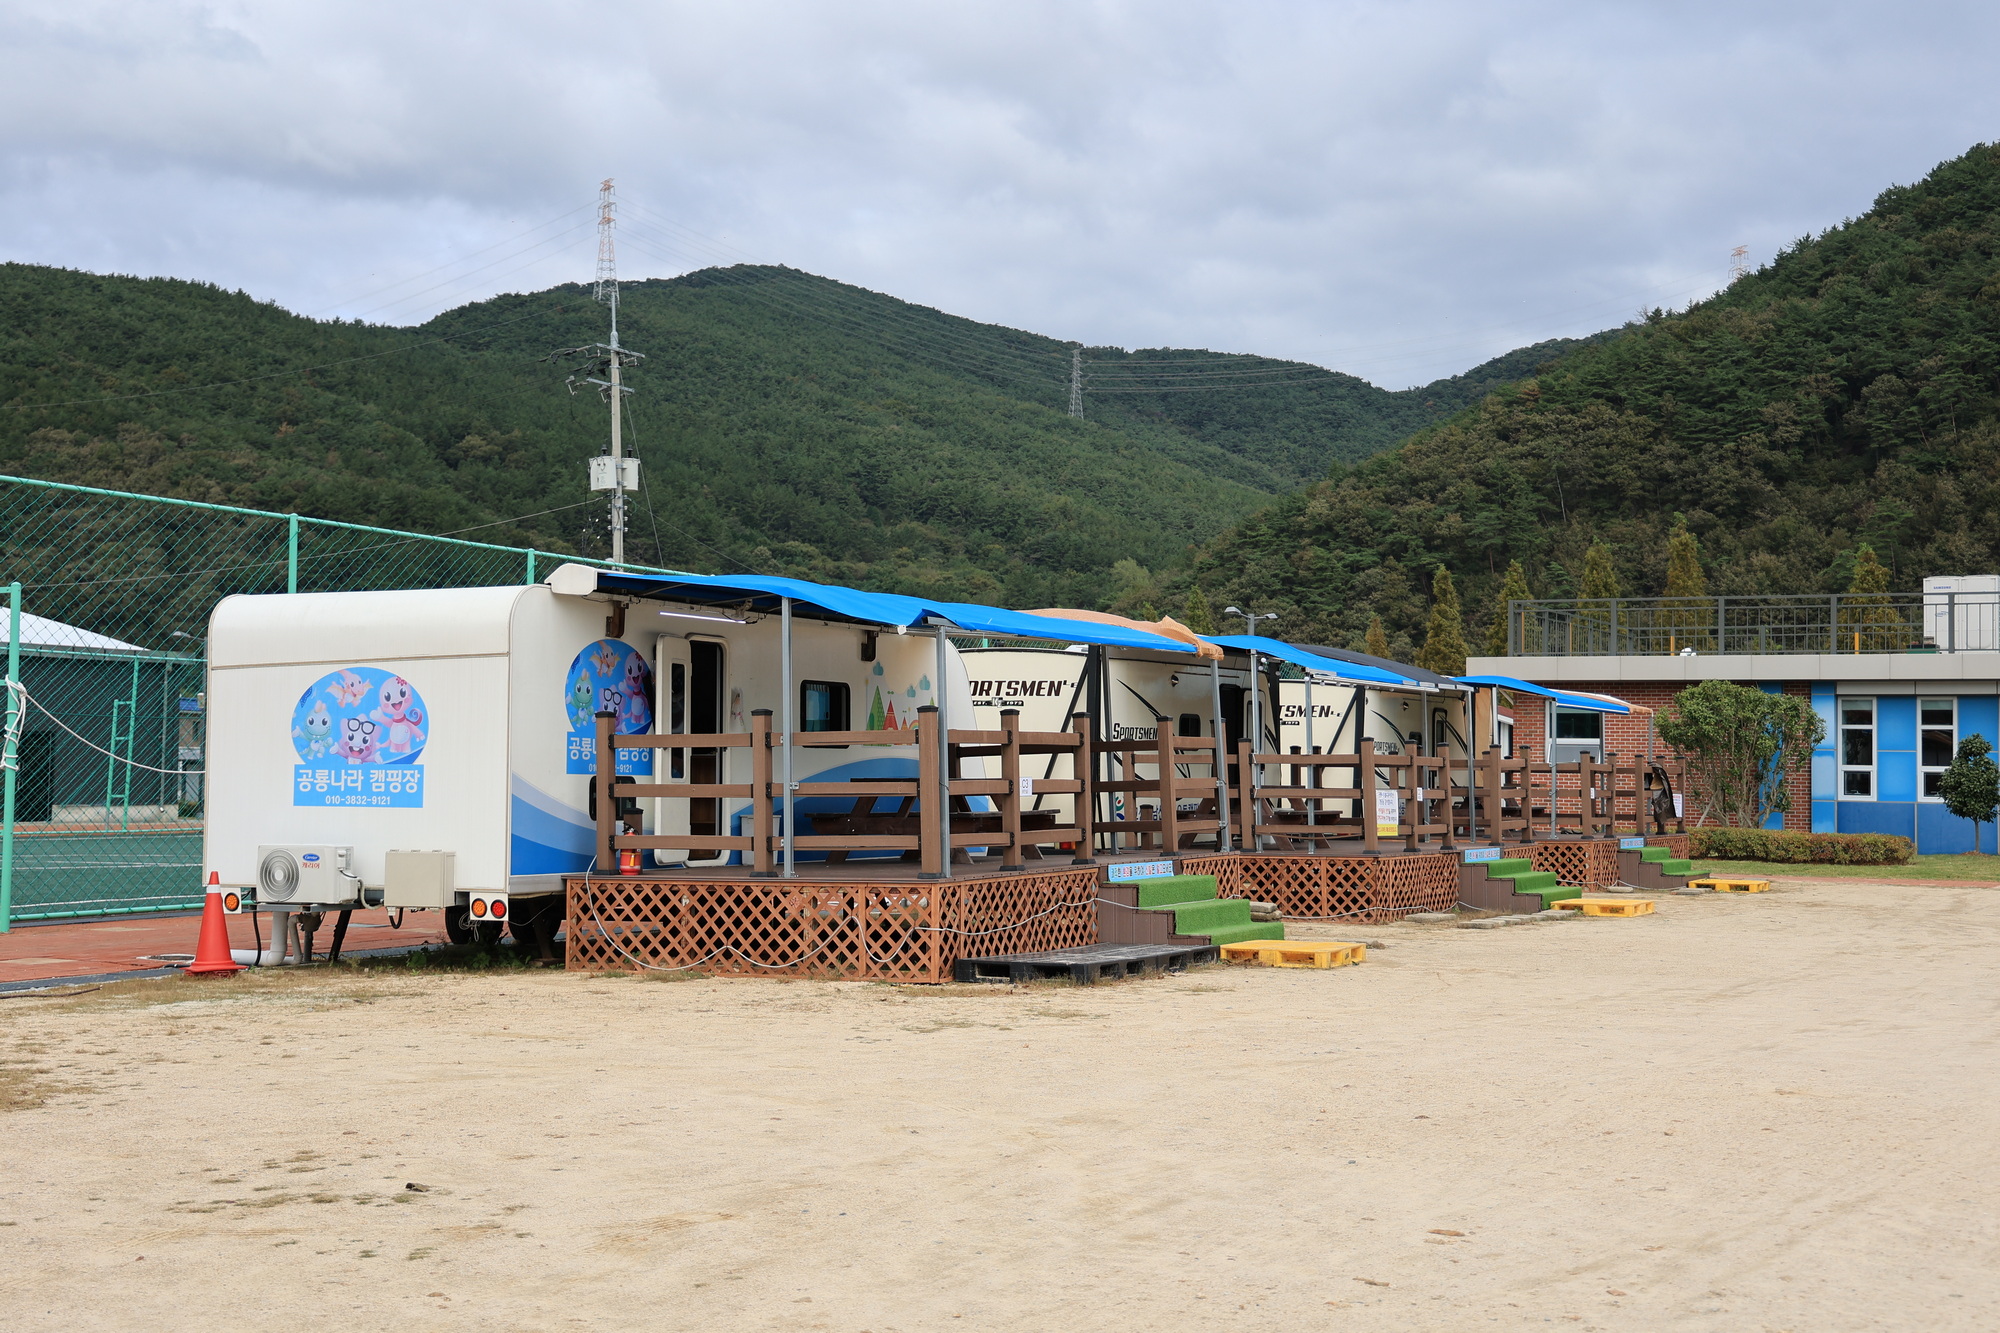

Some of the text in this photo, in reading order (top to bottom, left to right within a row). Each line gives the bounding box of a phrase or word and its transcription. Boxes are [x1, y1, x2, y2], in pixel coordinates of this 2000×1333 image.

[969, 680, 1062, 697] ORTSMEN
[1113, 722, 1158, 740] SPORTSMEN
[297, 769, 421, 793] 공룡나라 캠핑장
[325, 795, 391, 805] 010-3832-9121
